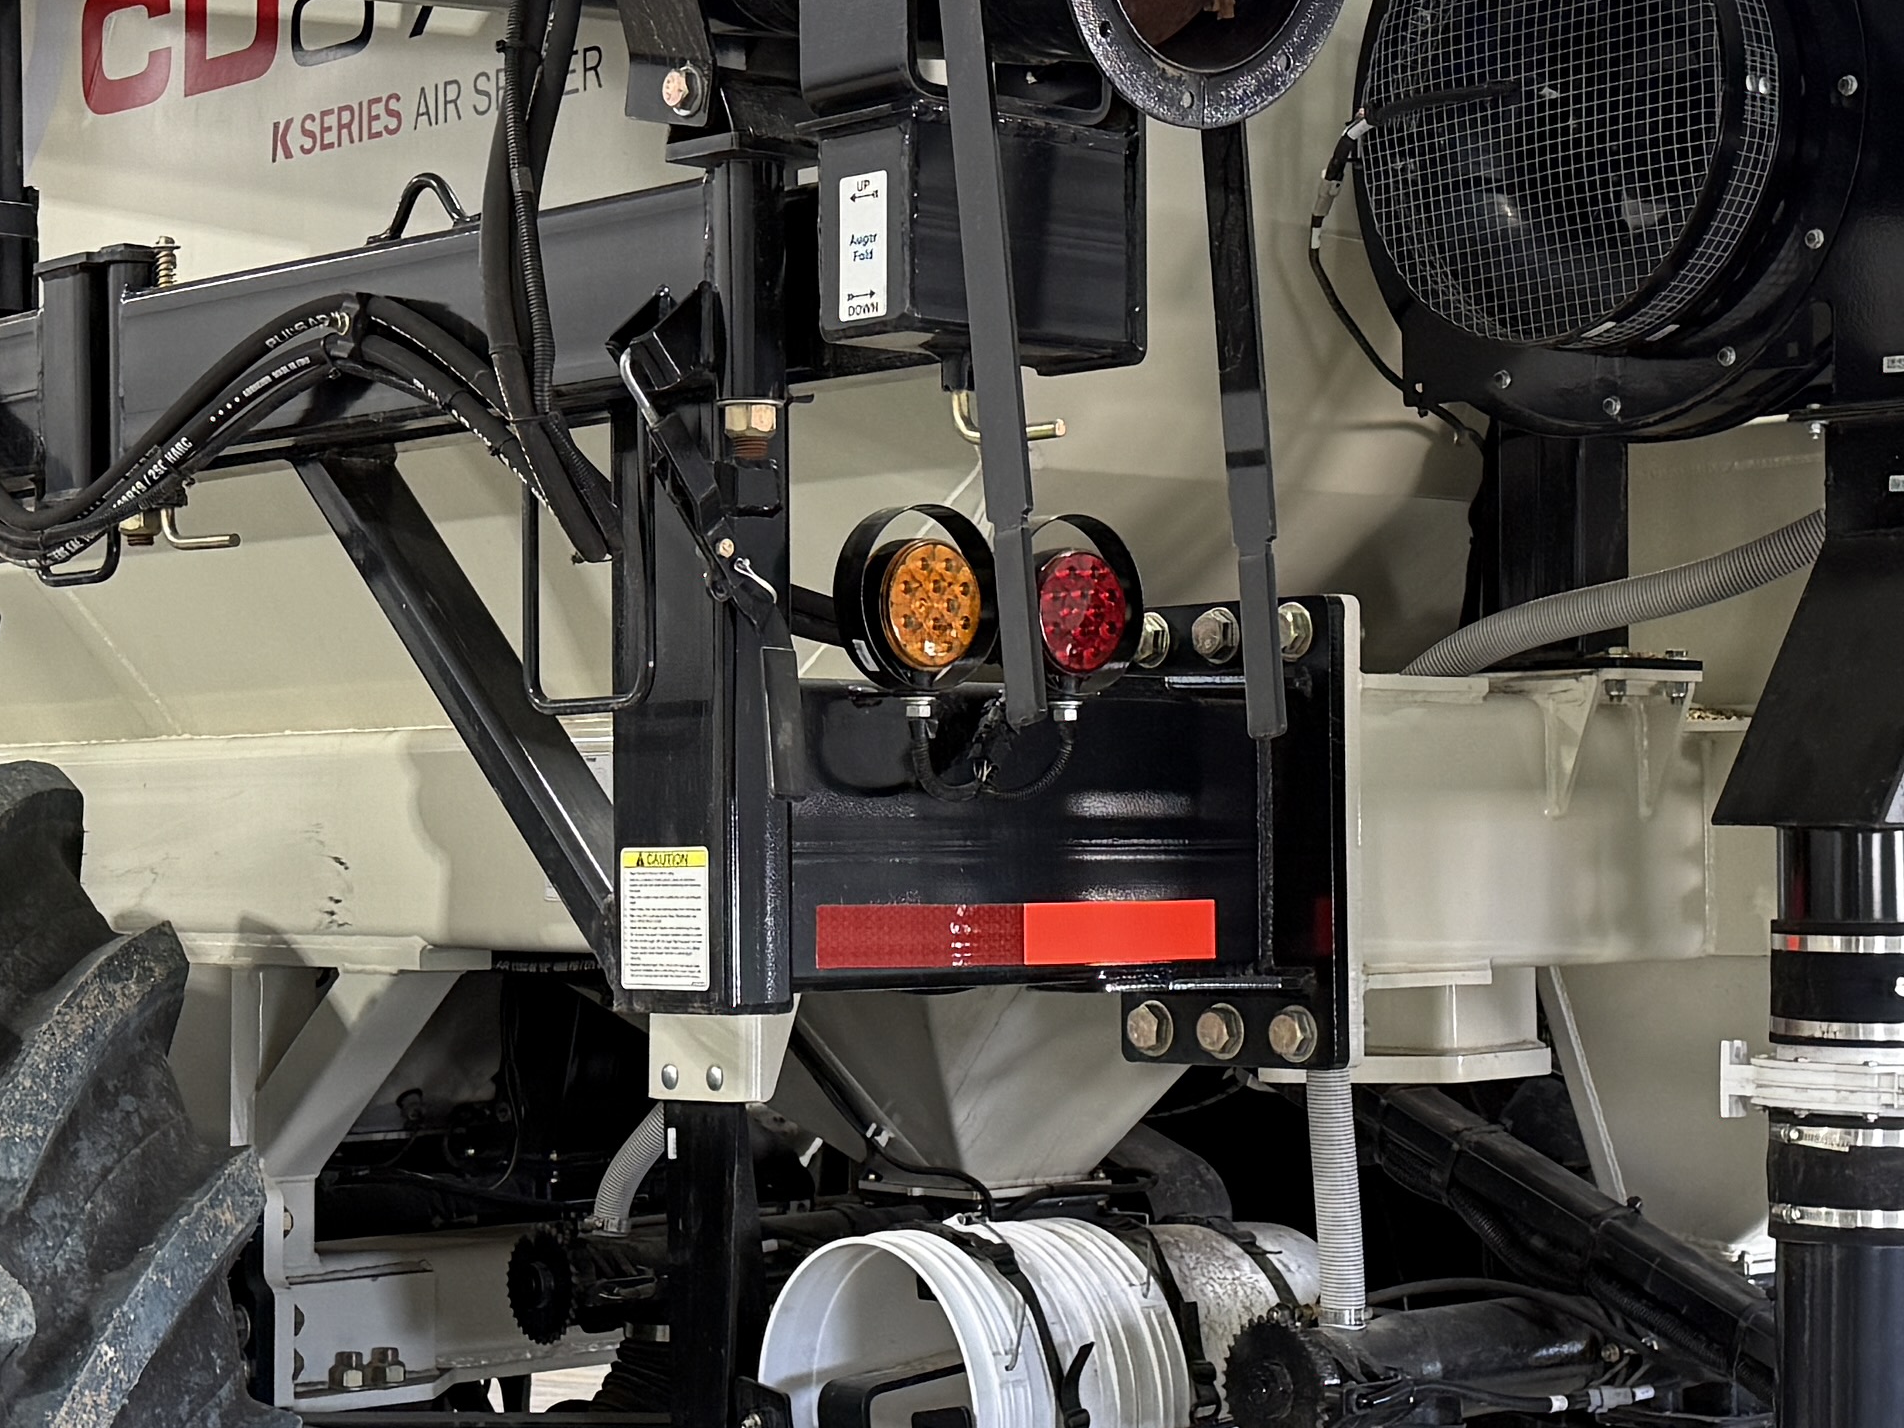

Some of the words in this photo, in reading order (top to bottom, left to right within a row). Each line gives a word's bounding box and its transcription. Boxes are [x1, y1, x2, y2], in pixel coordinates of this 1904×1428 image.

[271, 121, 295, 164] K
[299, 92, 402, 155] SERIES
[414, 78, 463, 131] AIR
[856, 179, 871, 193] UP
[847, 301, 879, 317] DOWN
[645, 852, 689, 867] CAUTION
